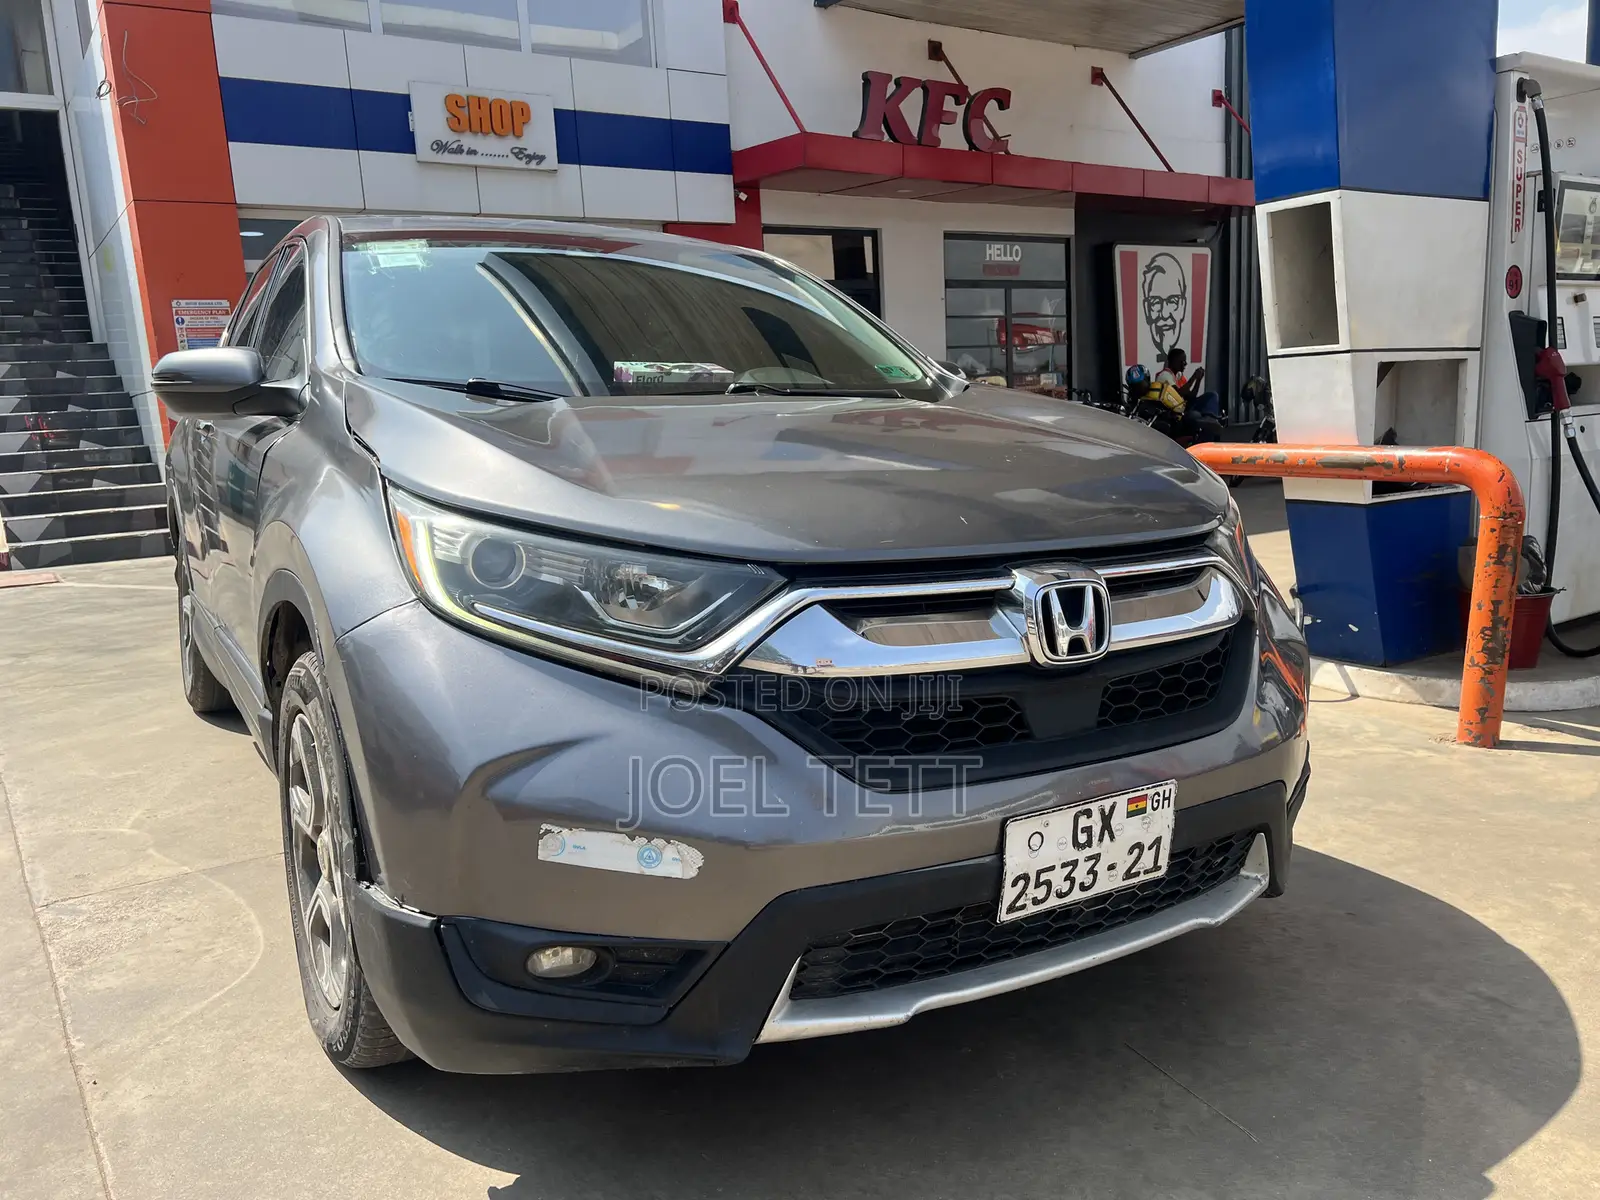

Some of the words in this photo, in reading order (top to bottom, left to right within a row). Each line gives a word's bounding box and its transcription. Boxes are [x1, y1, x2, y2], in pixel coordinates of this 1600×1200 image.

[444, 93, 531, 138] SHOP
[852, 70, 1012, 153] KFC
[430, 139, 465, 155] Walk
[510, 146, 547, 165] Enjoy
[1514, 148, 1524, 233] SUPER
[985, 243, 1022, 262] HELLO
[1072, 801, 1117, 851] GX
[1151, 788, 1172, 812] GH
